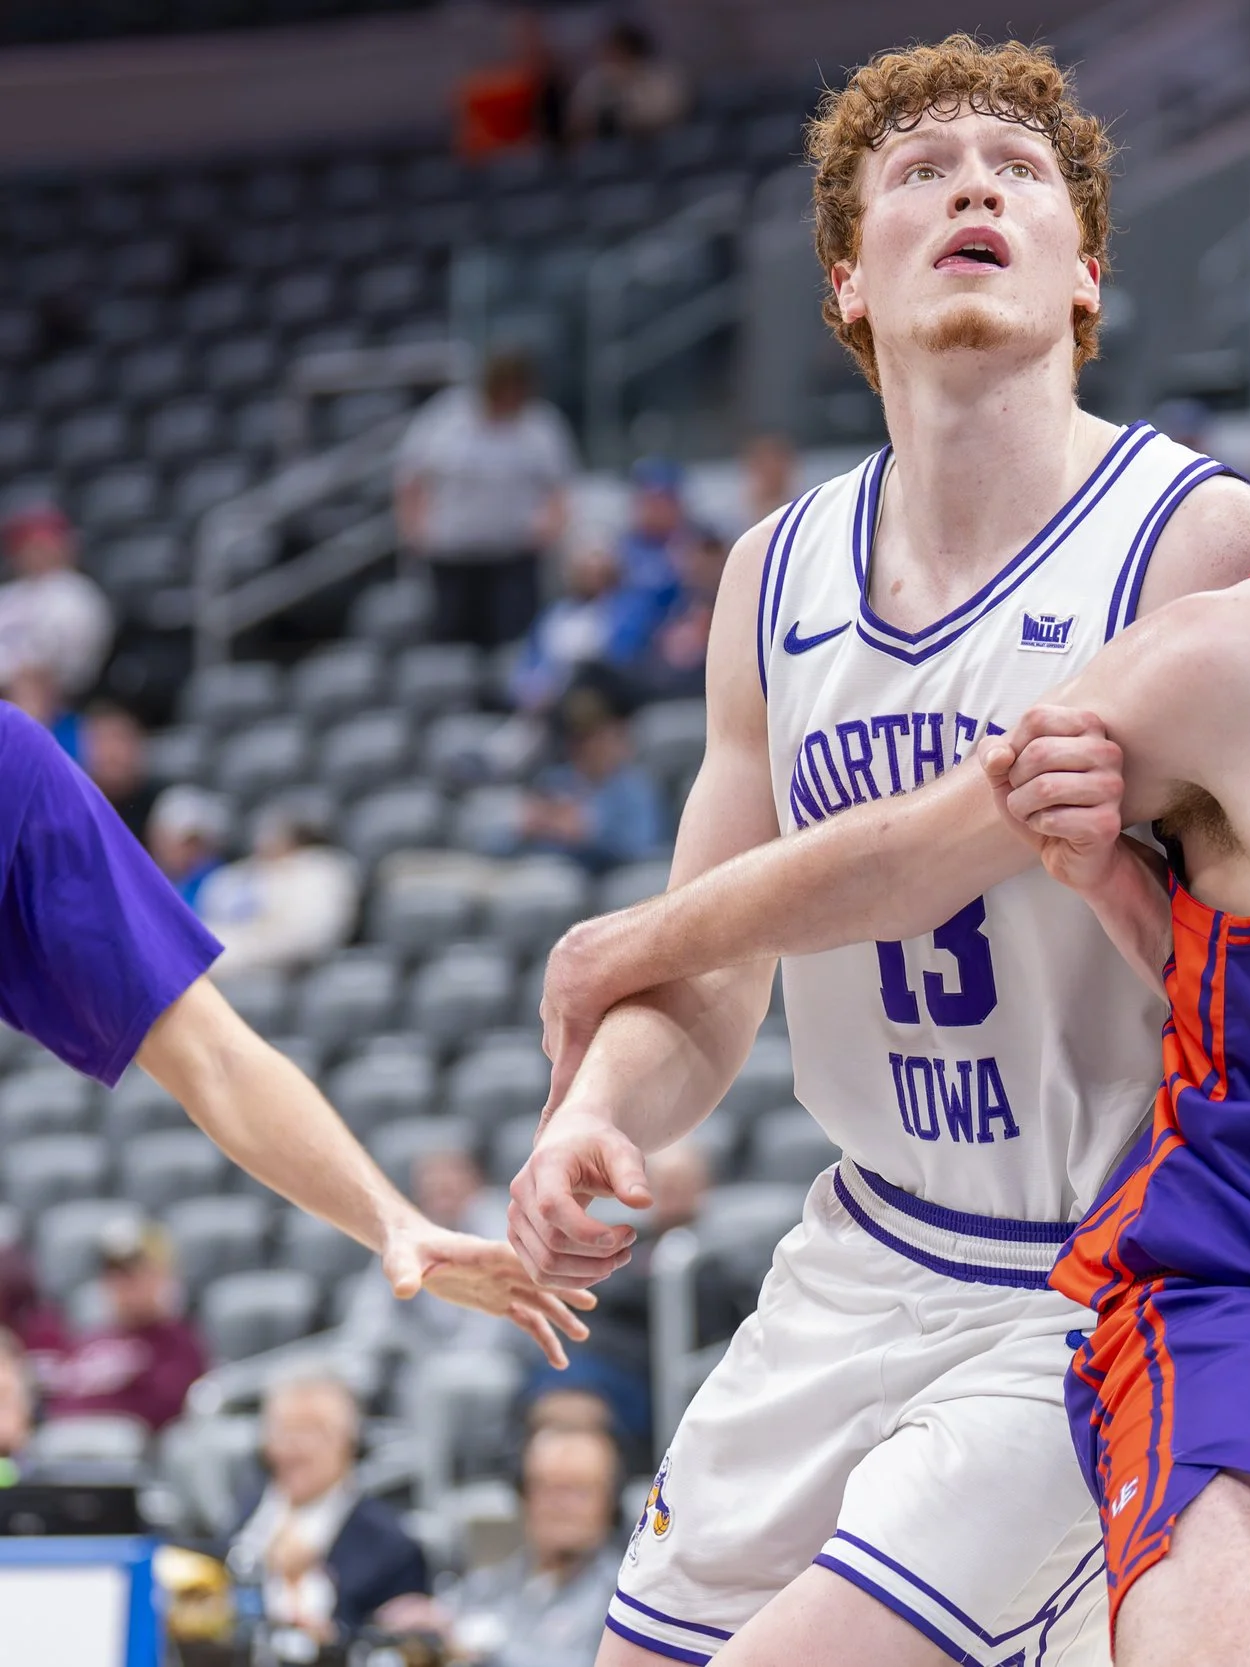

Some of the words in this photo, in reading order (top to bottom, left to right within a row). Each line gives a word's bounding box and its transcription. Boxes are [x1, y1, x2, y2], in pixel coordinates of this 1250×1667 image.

[1022, 613, 1073, 643] VALLEY
[790, 711, 1007, 830] NORTHE
[889, 1052, 1020, 1143] IOWA
